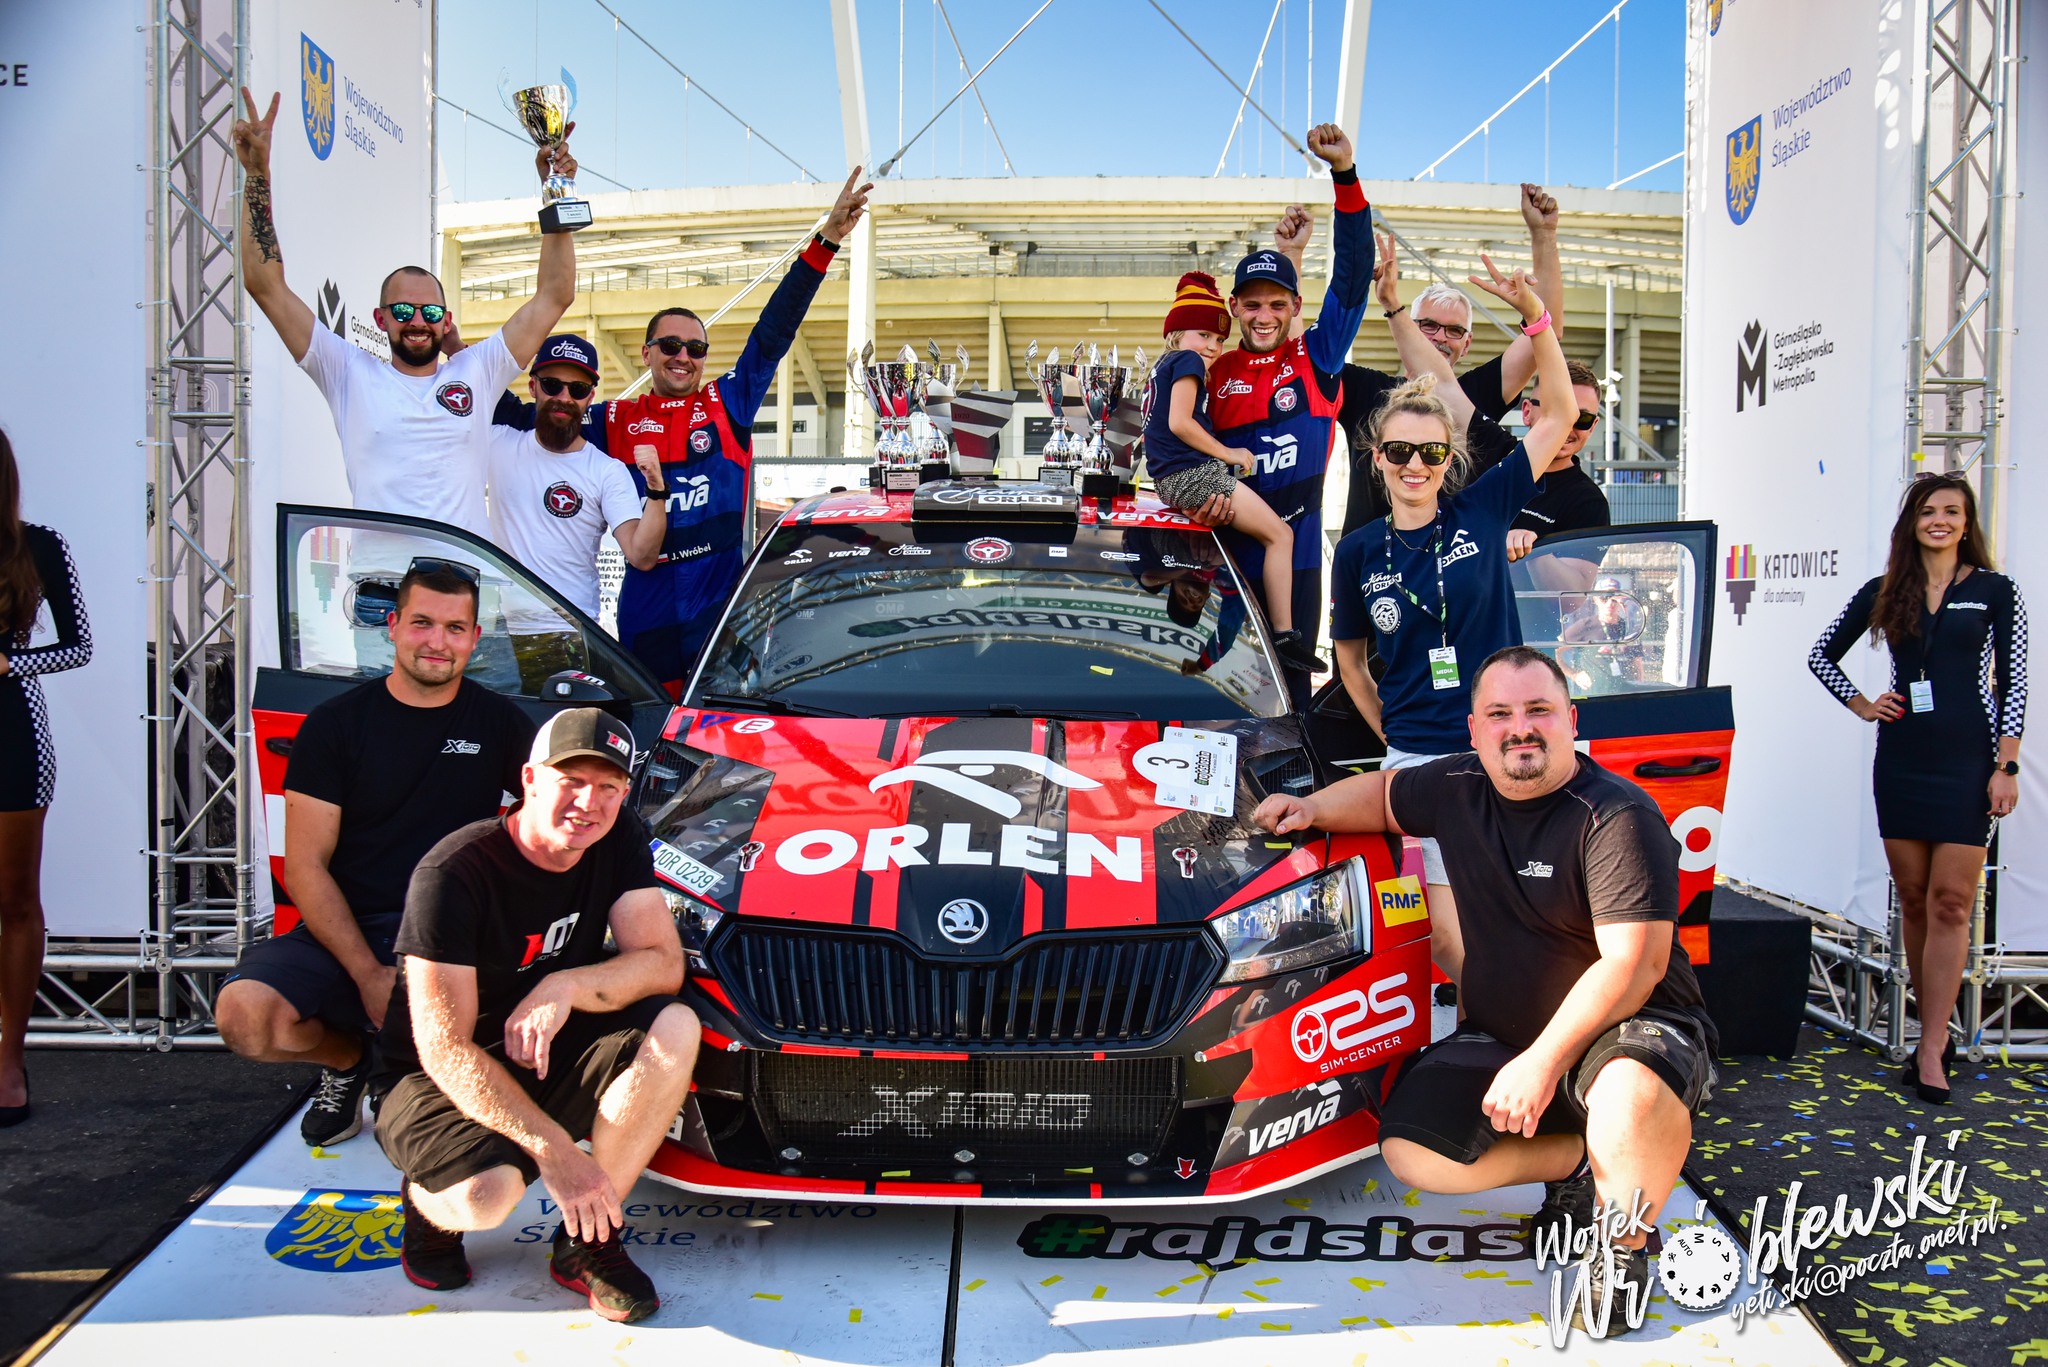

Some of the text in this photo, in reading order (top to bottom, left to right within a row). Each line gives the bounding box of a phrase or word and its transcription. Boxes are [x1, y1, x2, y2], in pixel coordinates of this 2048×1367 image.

[1772, 67, 1852, 131] Województwo
[344, 75, 404, 144] Województwo
[344, 110, 376, 158] Śląskie
[1771, 129, 1811, 168] Śląskie
[1773, 319, 1822, 350] Górnośląsko
[566, 351, 587, 362] ORLEN
[1248, 355, 1276, 365] HRX
[1772, 366, 1816, 393] Metropolia
[661, 399, 686, 409] HRX
[641, 425, 663, 433] ORLEN
[794, 508, 888, 521] verva
[1097, 511, 1191, 525] verva
[671, 543, 711, 561] J. Wróbel
[828, 547, 871, 557] verva
[784, 557, 813, 566] ORLEN
[1764, 550, 1838, 579] KATOWICE
[796, 610, 815, 618] OMP
[875, 602, 905, 615] OMP
[1147, 757, 1190, 769] 3
[775, 823, 1143, 882] ORLEN
[675, 858, 714, 889] 0239
[1380, 892, 1422, 910] RMF
[1320, 1035, 1402, 1074] SIM-CENTER
[1248, 1094, 1341, 1156] verva
